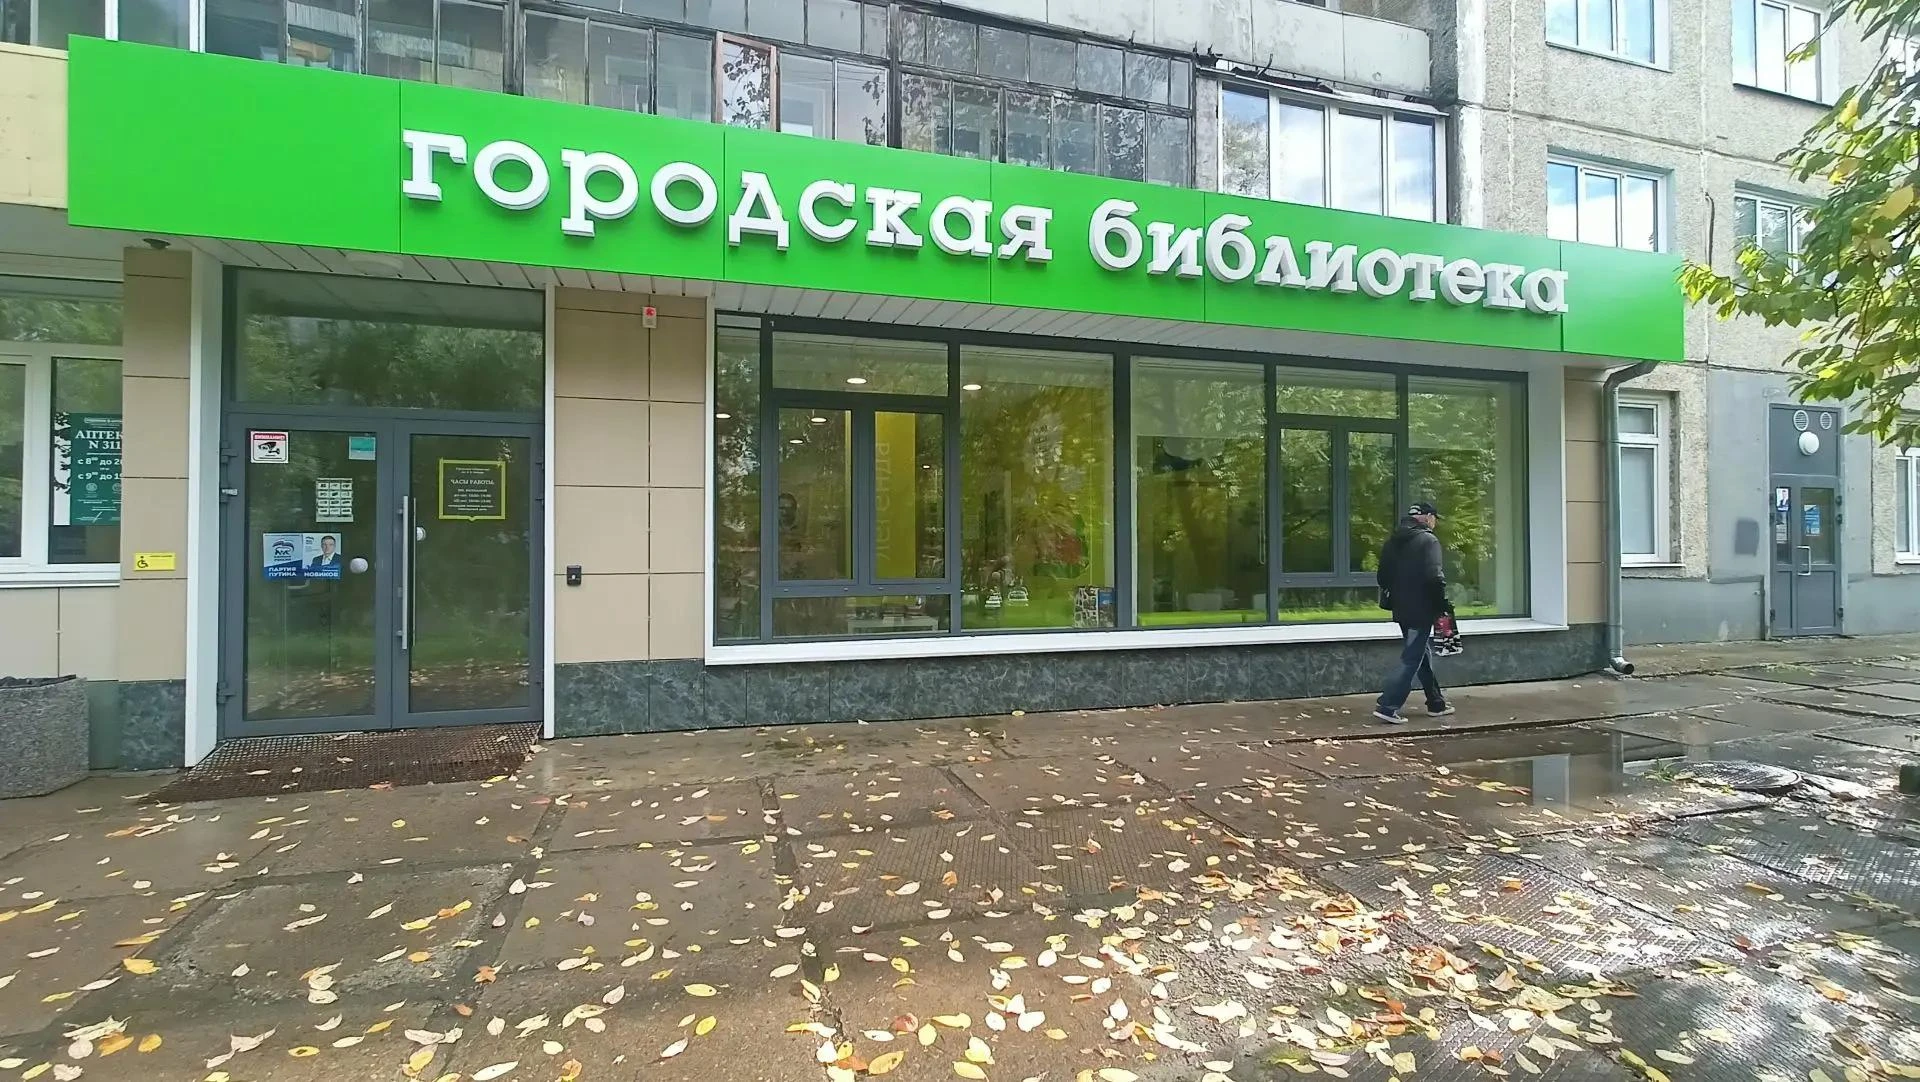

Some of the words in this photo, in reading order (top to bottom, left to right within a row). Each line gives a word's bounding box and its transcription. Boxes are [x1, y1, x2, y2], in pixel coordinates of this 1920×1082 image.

[401, 129, 1053, 263] городская
[1088, 198, 1569, 316] библиотека
[102, 440, 122, 450] 311
